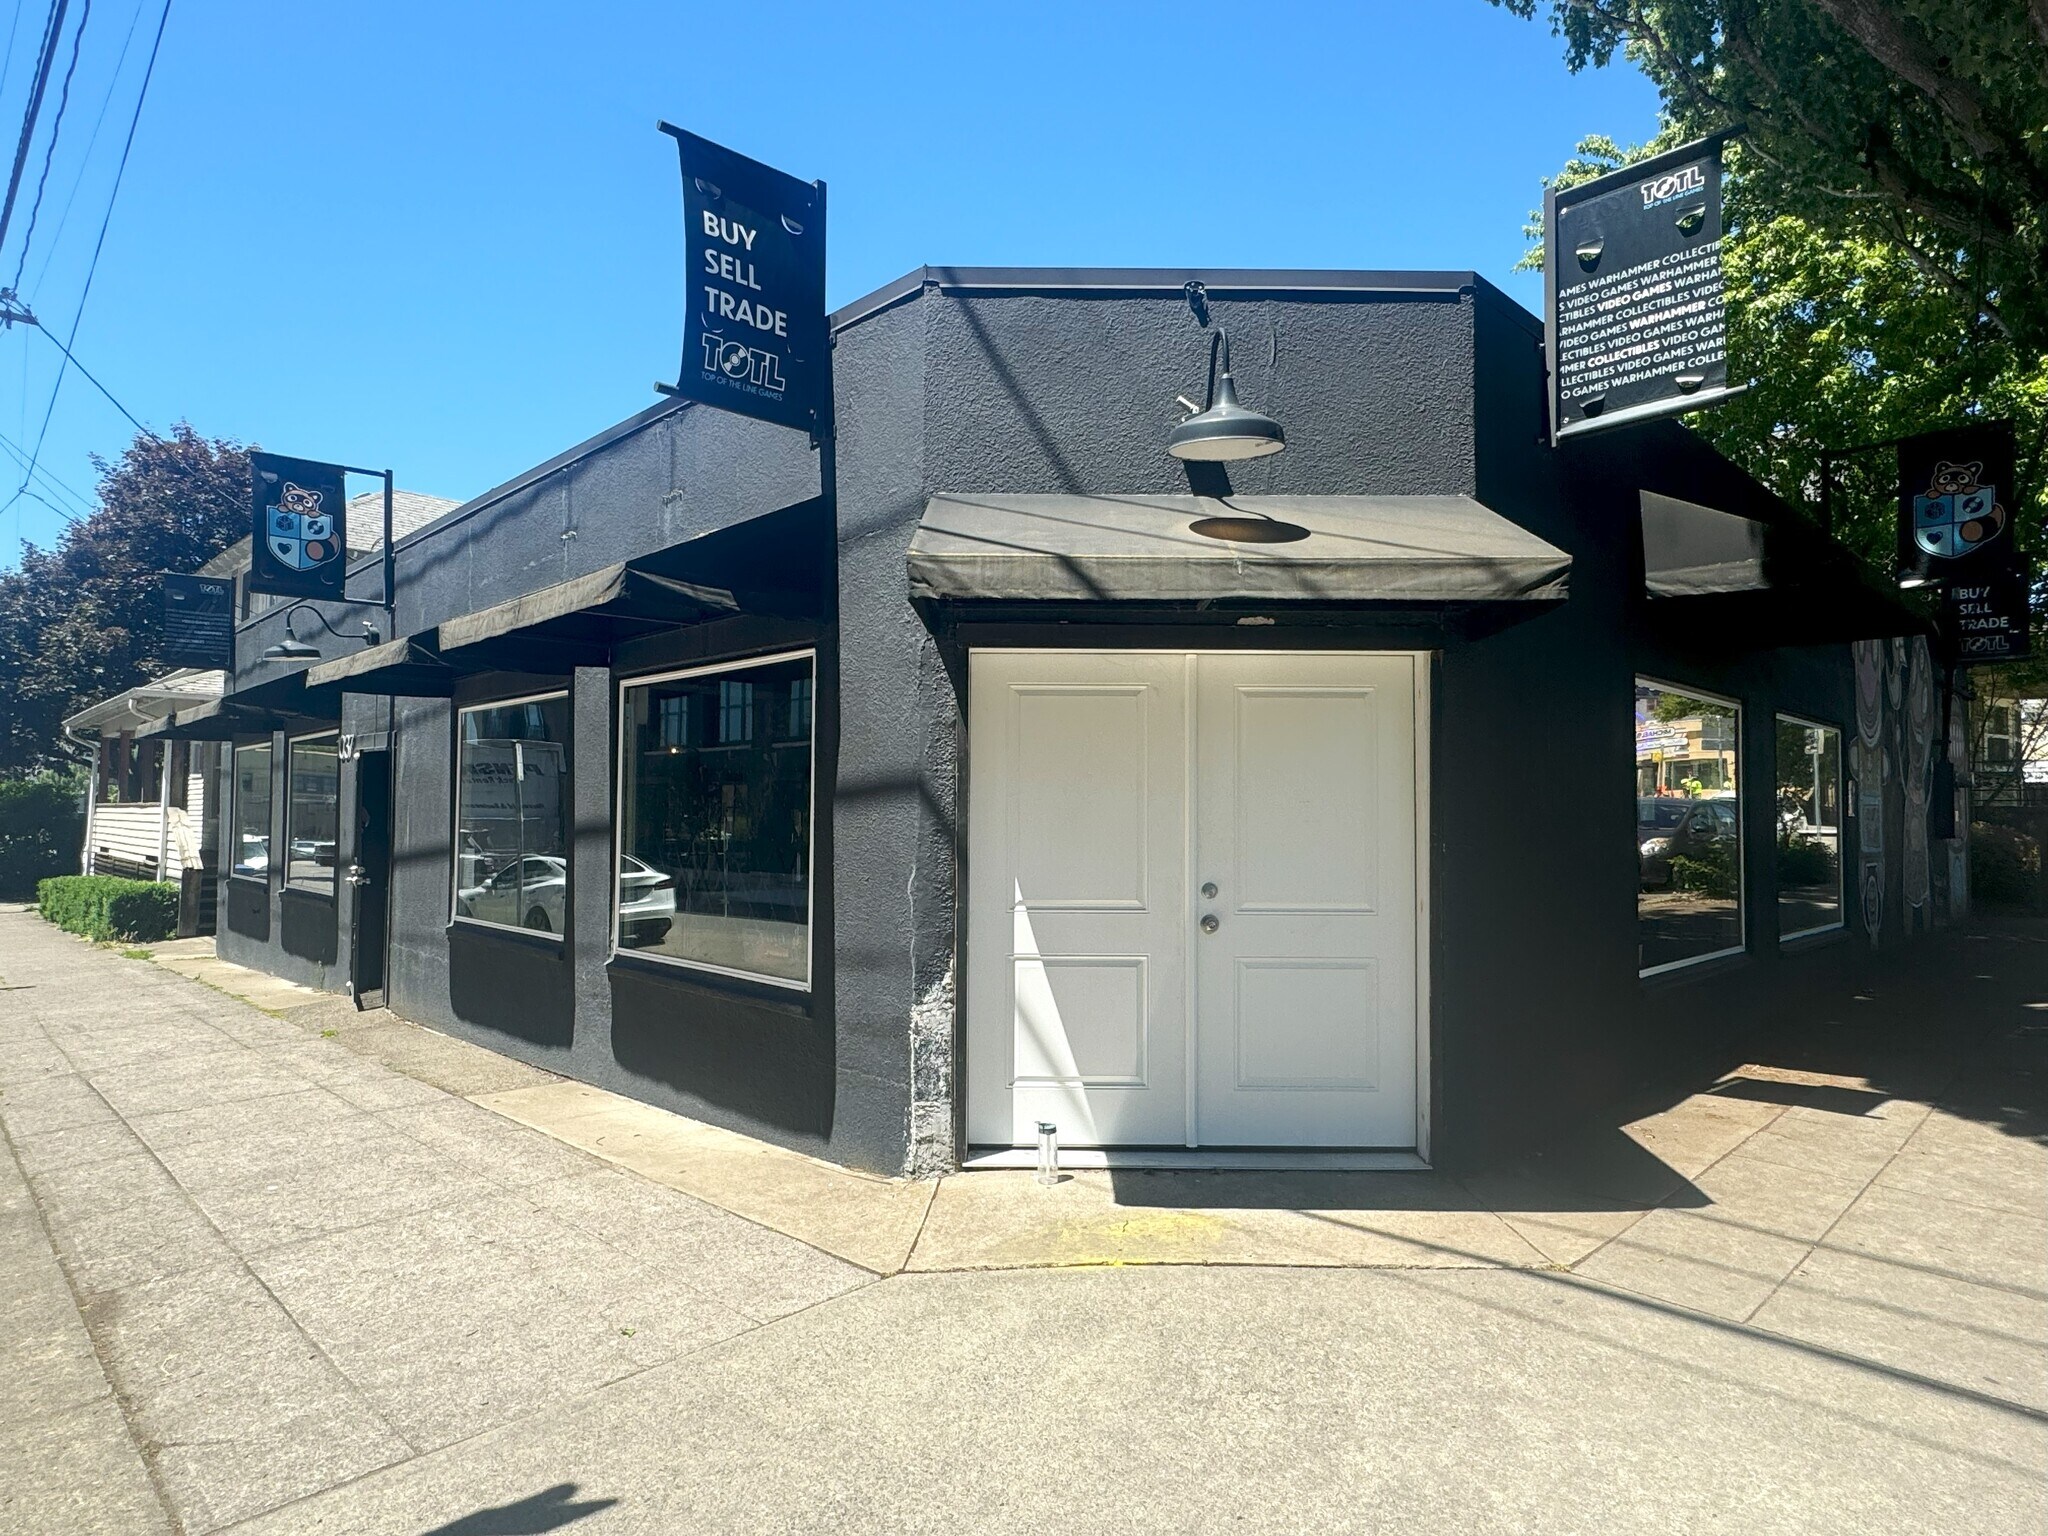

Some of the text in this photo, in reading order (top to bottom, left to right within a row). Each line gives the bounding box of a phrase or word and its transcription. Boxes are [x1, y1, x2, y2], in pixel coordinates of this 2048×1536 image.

[1641, 165, 1705, 204] TOTL
[703, 210, 757, 251] BUY
[704, 248, 761, 291] SELL
[1558, 283, 1587, 298] AMES
[1588, 259, 1660, 289] WARHAMMER
[1559, 302, 1565, 311] S
[1566, 292, 1599, 308] VIDEO
[1601, 279, 1639, 298] GAMES
[1640, 256, 1717, 286] WARHAMMER
[704, 285, 787, 338] TRADE
[1597, 294, 1631, 312] VIDEO
[1632, 281, 1673, 300] GAMES
[1615, 291, 1690, 320] COLLECTIBLES
[1590, 322, 1628, 340] GAMES
[1629, 300, 1706, 330] WARHAMMER
[1607, 332, 1641, 348] VIDEO
[1643, 320, 1683, 338] GAMES
[702, 332, 786, 392] TOTL
[1561, 336, 1726, 387] LLECTIBLES VIDEO GAMES WAR
[1587, 340, 1660, 368] COLLECTIBLES
[1662, 330, 1698, 347] VIDEO
[701, 371, 783, 401] TOP OF THE LINE GAMES
[1561, 390, 1571, 400] O
[1572, 380, 1609, 397] GAMES
[1611, 361, 1685, 387] WARHAMMER
[1959, 586, 1991, 600] BUY
[1959, 602, 1992, 615] SELL
[1959, 616, 2010, 630] TRADE
